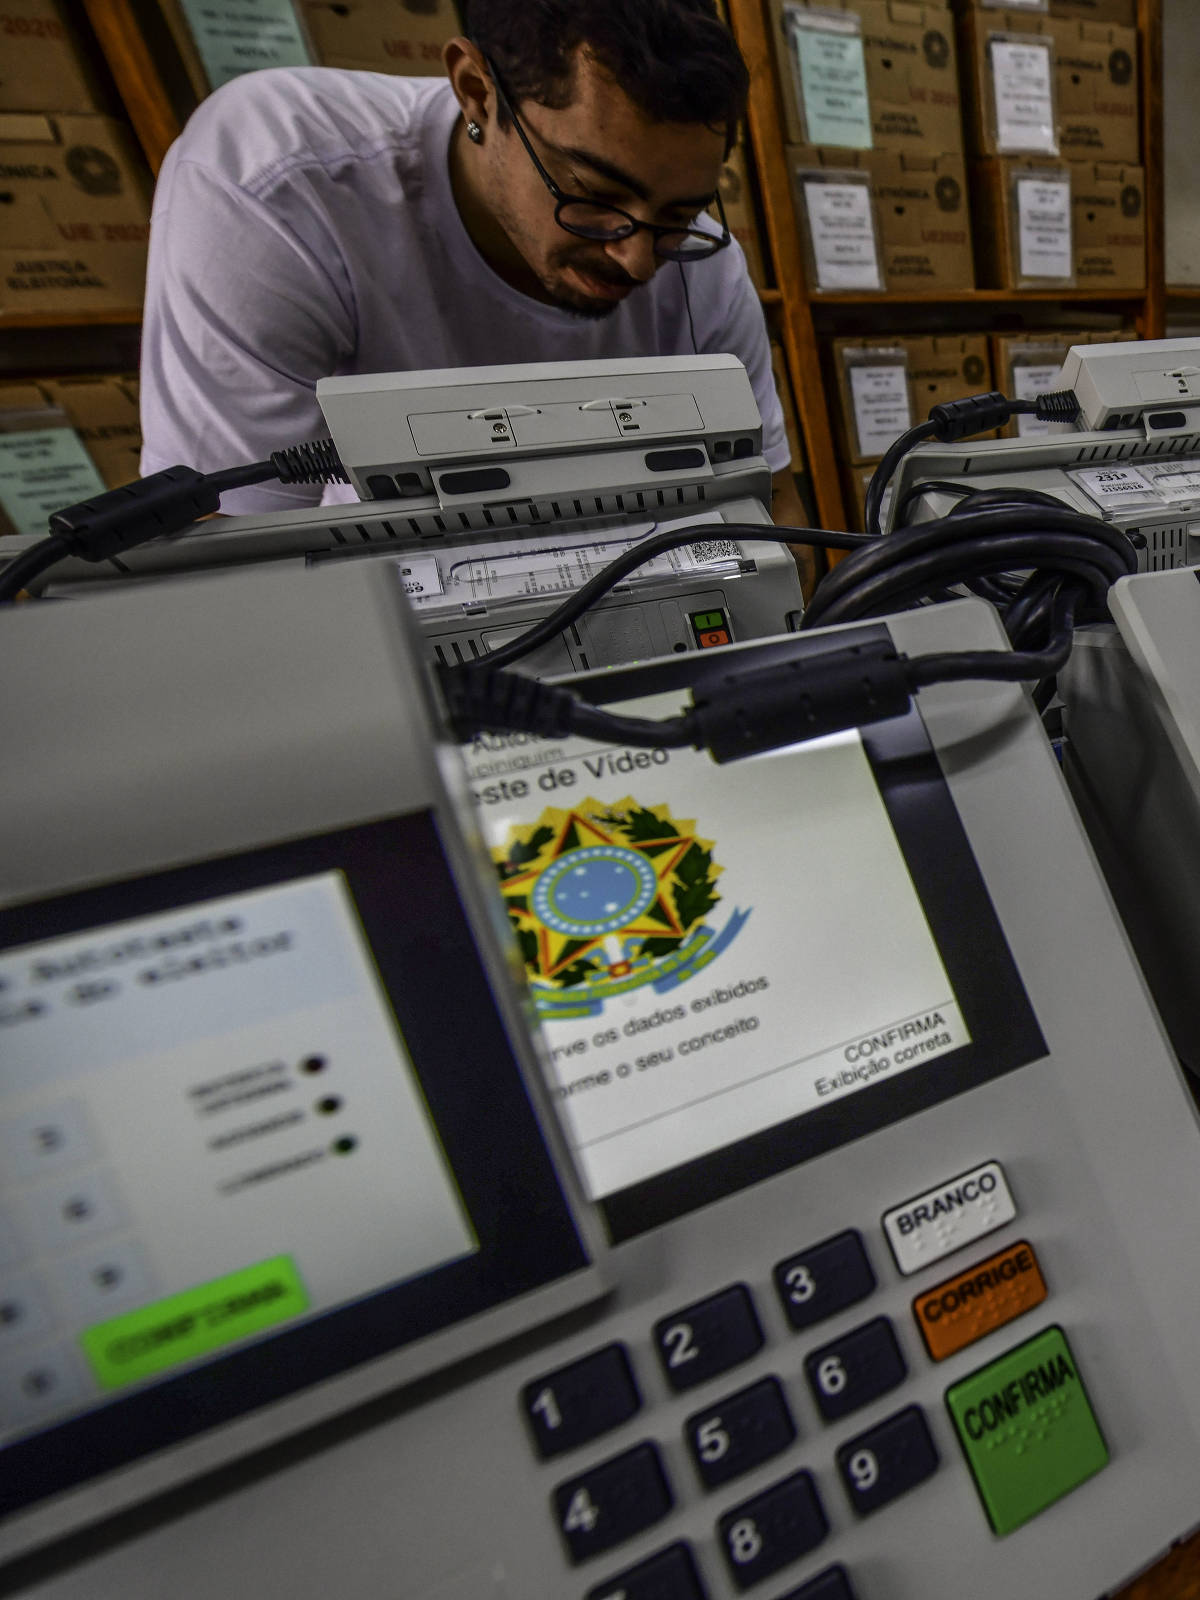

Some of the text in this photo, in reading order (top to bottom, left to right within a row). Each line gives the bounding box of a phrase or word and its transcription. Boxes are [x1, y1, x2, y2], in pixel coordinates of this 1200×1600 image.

[538, 767, 577, 793] de
[583, 747, 670, 780] Vídeo
[592, 1027, 620, 1048] os
[623, 1004, 687, 1037] dados
[690, 975, 770, 1014] exibidos
[615, 1062, 631, 1079] o
[634, 1047, 675, 1072] seu
[677, 1015, 760, 1057] conceito
[843, 1011, 947, 1063] CONFIRMA
[814, 1031, 953, 1097] Exibição correta
[896, 1171, 998, 1238] BRANCO
[784, 1264, 816, 1304] 3
[922, 1249, 1034, 1325] CORRIGE
[663, 1322, 699, 1369] 2
[815, 1355, 848, 1397] 6
[962, 1353, 1075, 1444] CONFIRMA
[531, 1388, 563, 1430] 1
[697, 1415, 729, 1465] 5
[847, 1448, 881, 1492] 9
[563, 1487, 598, 1534] 4
[726, 1518, 763, 1564] 8
